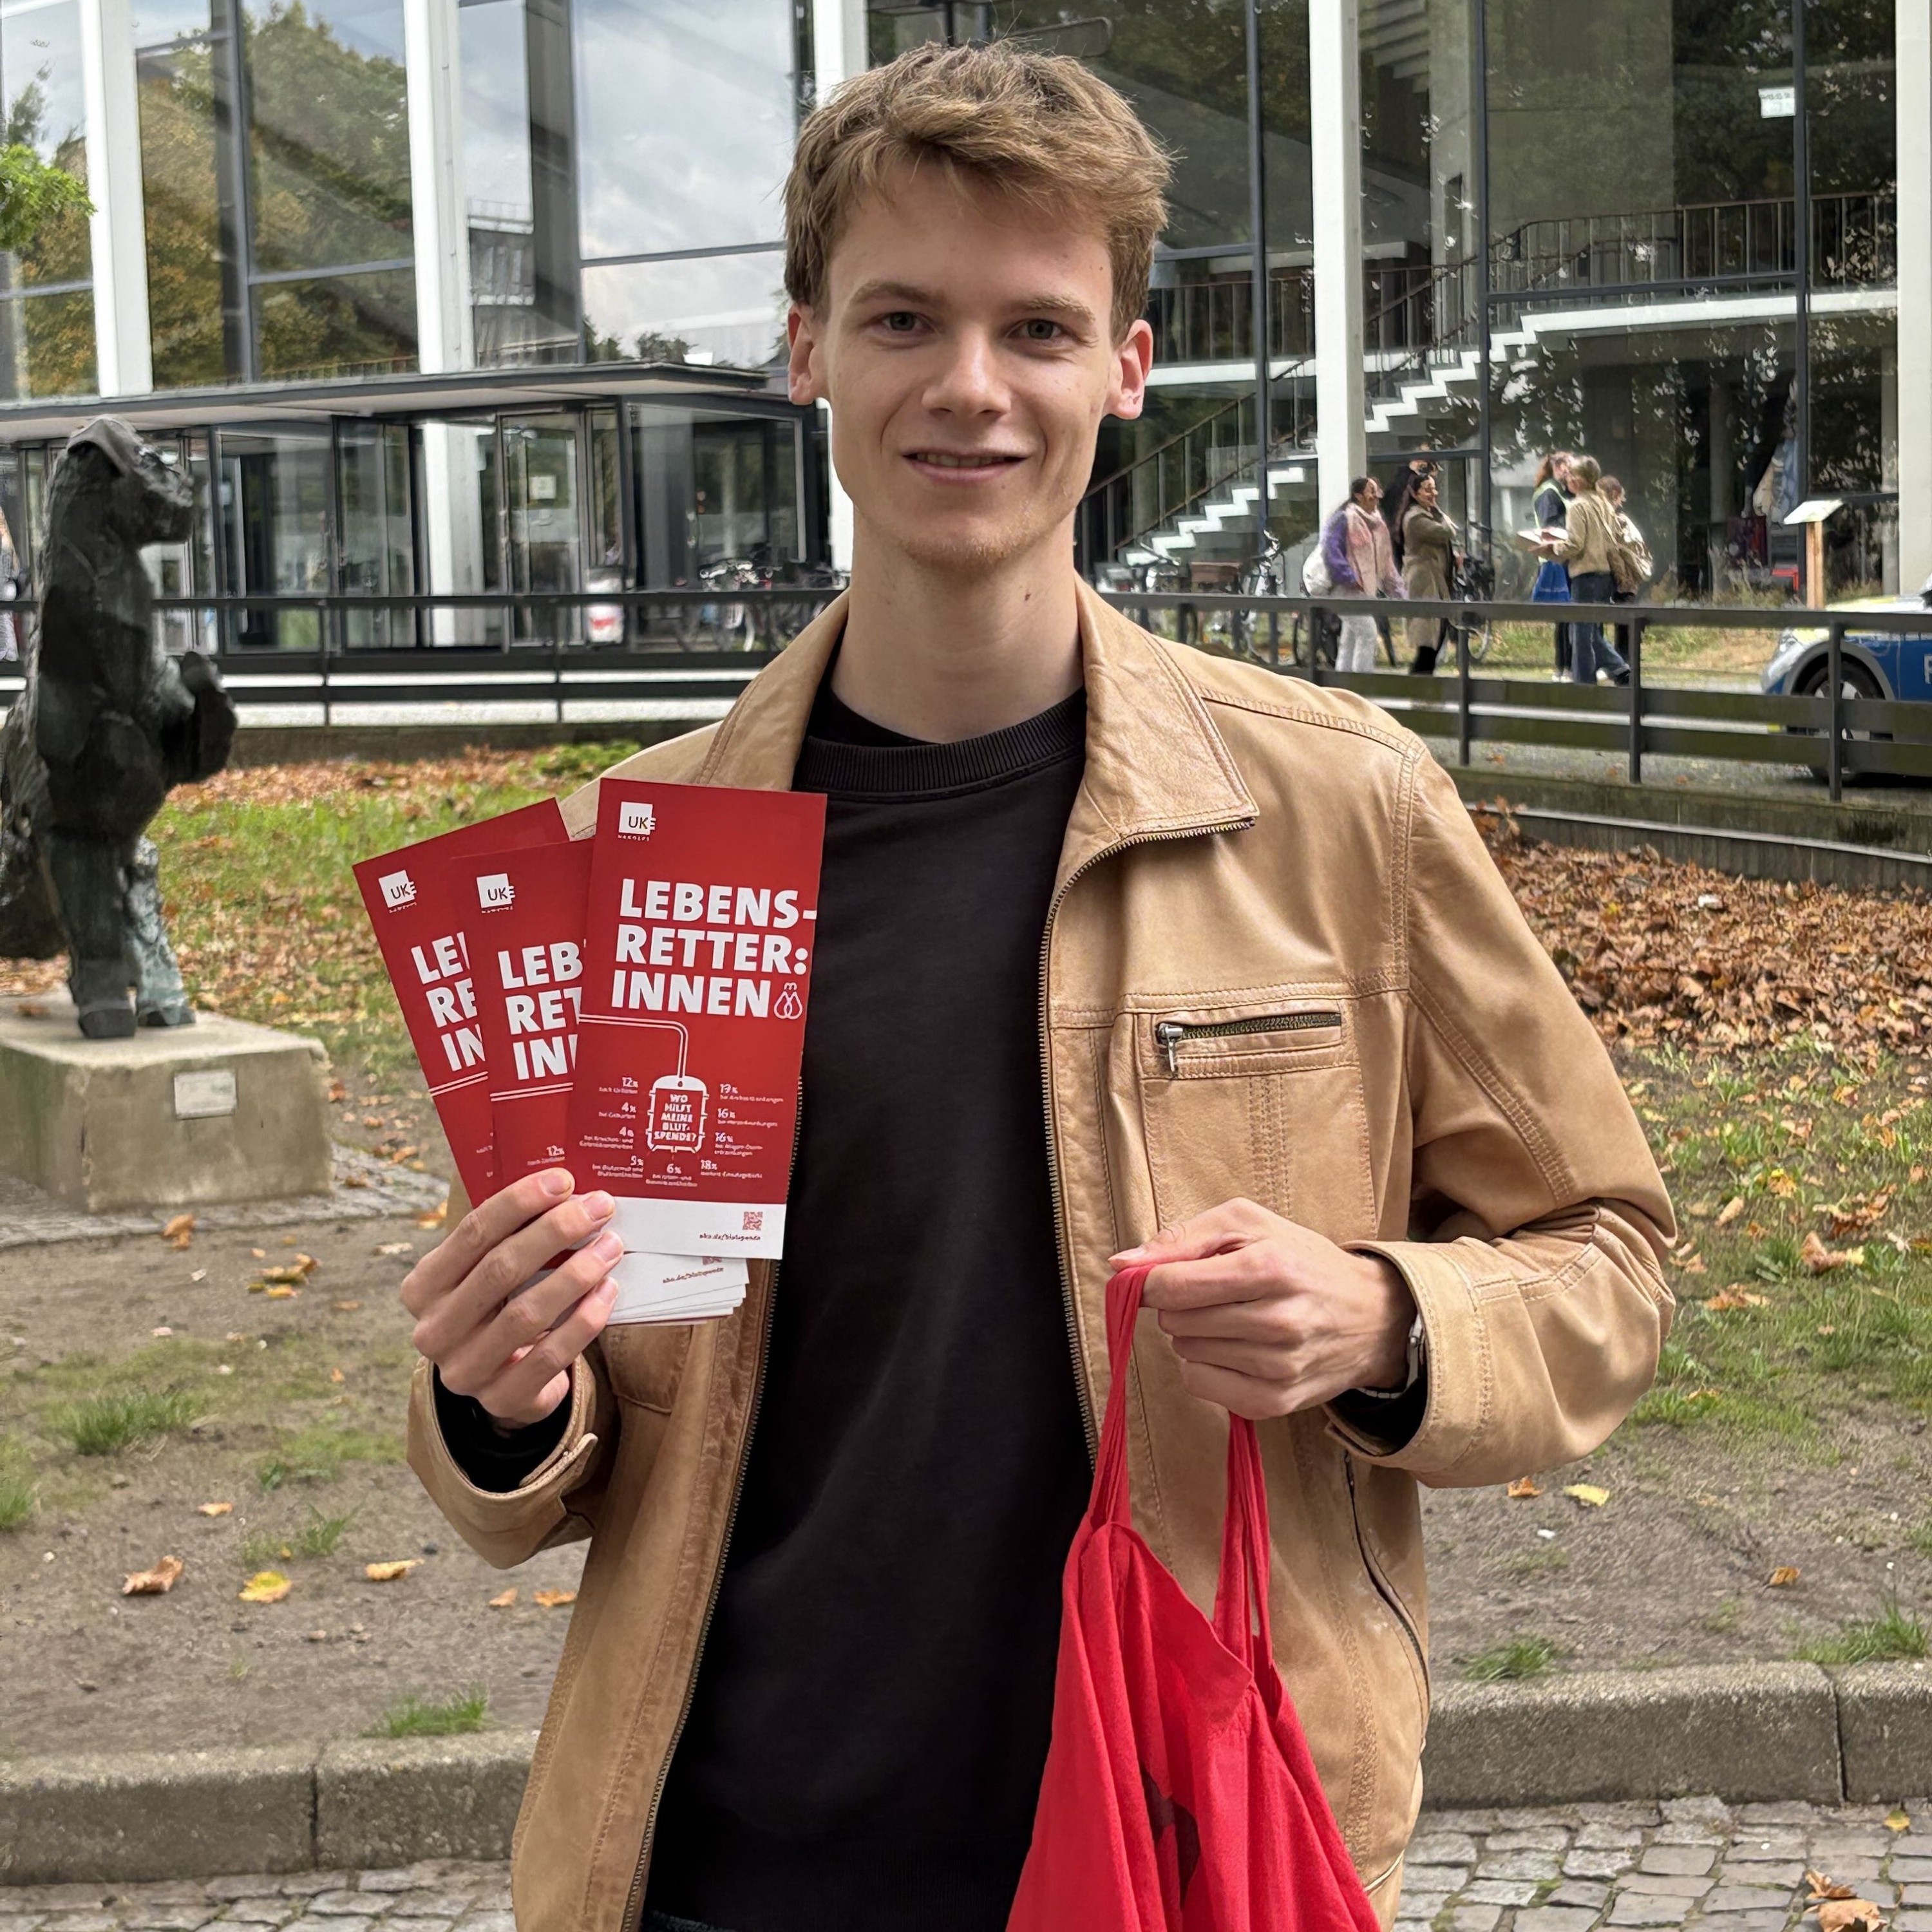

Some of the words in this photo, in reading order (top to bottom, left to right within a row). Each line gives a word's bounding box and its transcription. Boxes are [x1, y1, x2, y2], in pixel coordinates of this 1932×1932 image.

[620, 878, 817, 929] LEBENS-
[616, 924, 808, 975] RETTER:
[612, 969, 771, 1018] INNEN
[670, 1094, 688, 1103] WO
